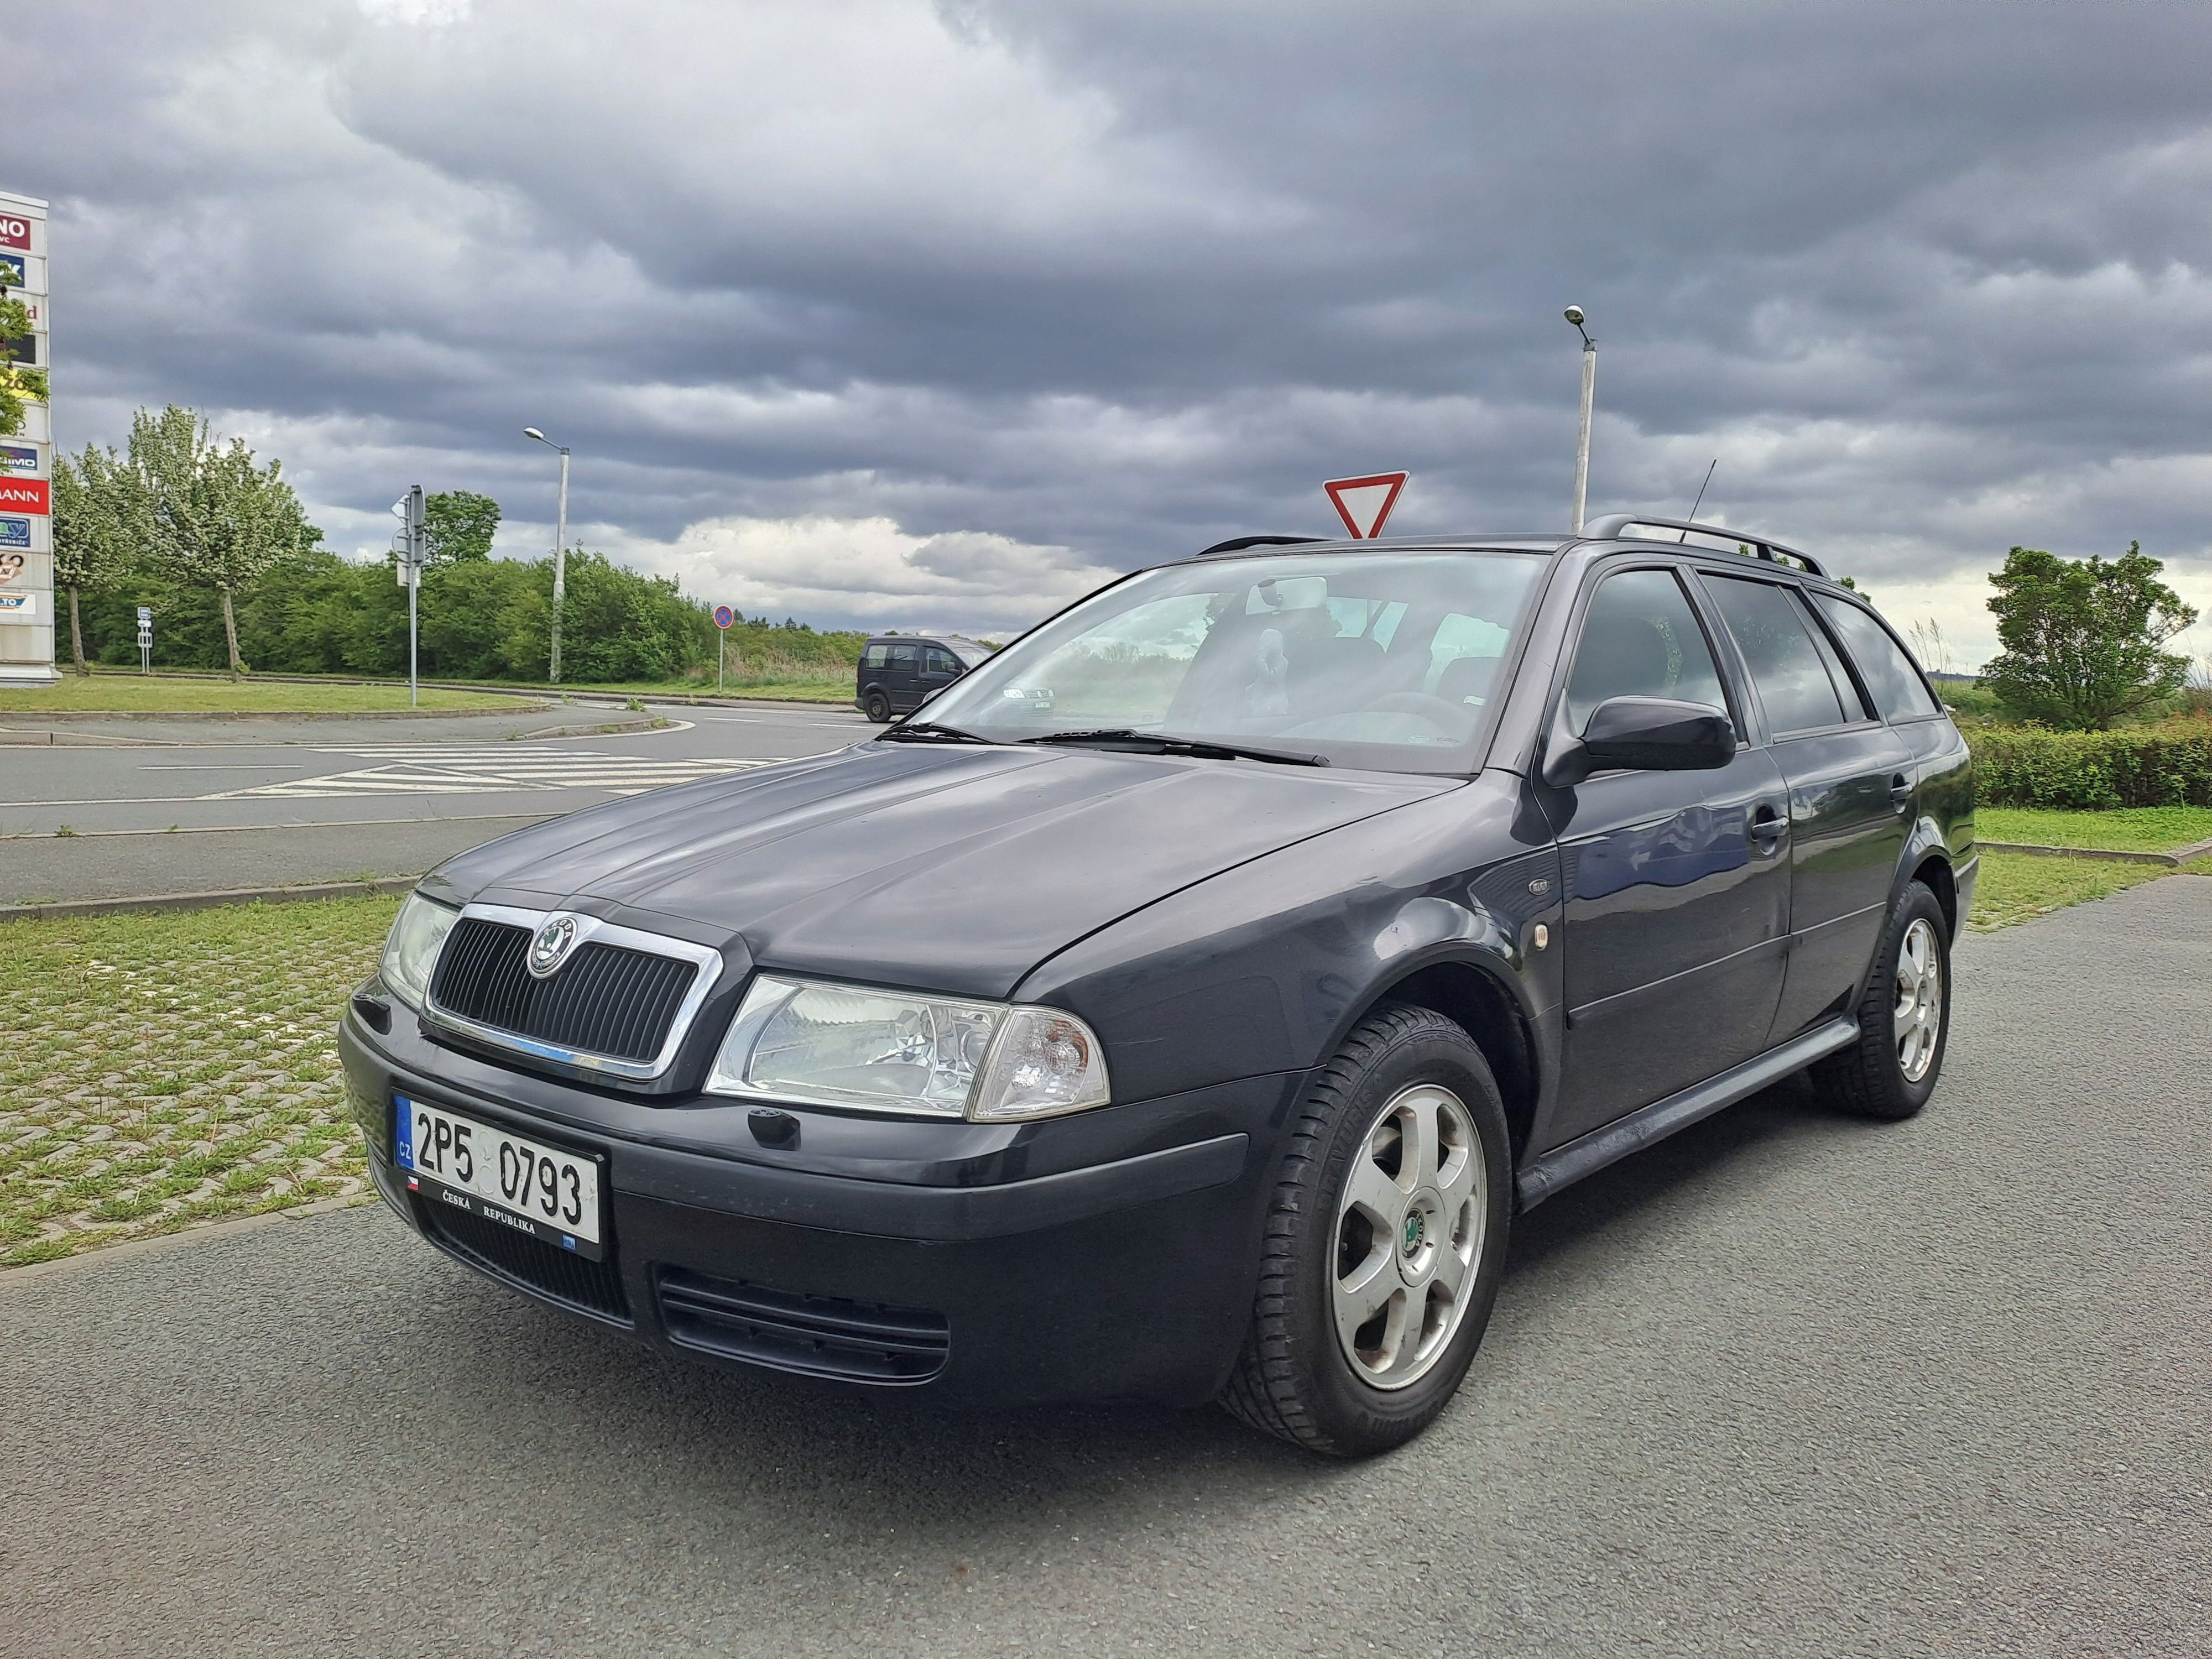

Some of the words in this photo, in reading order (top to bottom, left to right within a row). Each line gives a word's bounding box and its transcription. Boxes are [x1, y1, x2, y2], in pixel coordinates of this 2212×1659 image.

[0, 488, 39, 503] ANN
[399, 1140, 411, 1160] CZ
[418, 1113, 473, 1183] 2P5
[499, 1141, 582, 1225] 0793
[442, 1190, 472, 1210] ČESKÁ
[483, 1206, 536, 1235] REPUBLIKA
